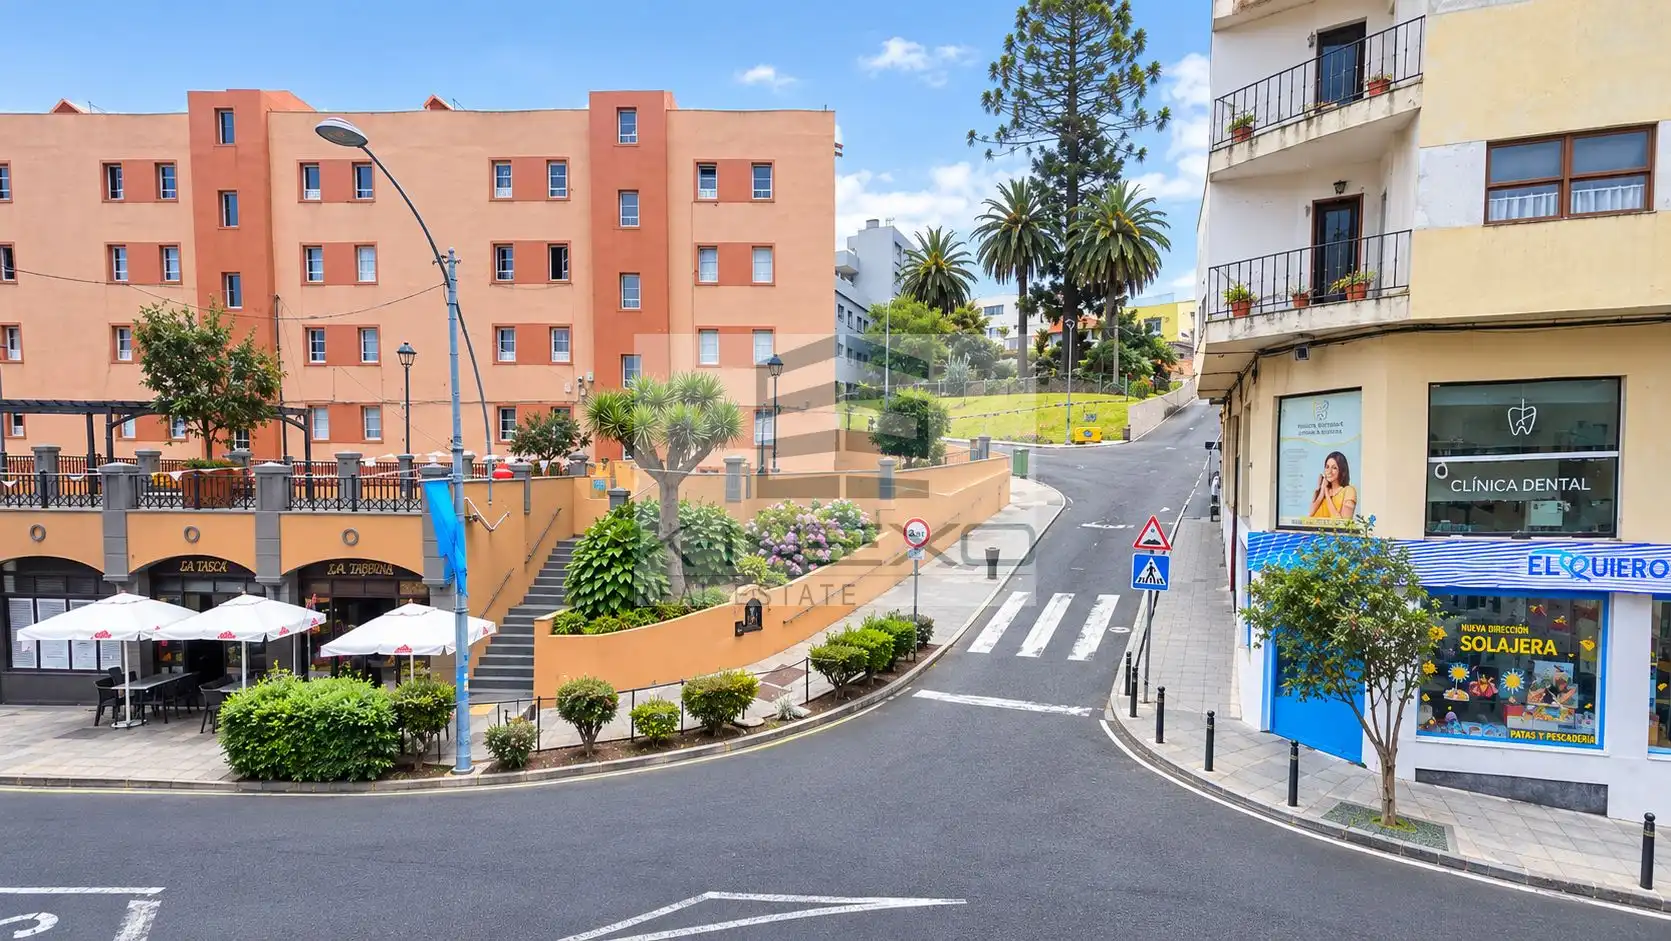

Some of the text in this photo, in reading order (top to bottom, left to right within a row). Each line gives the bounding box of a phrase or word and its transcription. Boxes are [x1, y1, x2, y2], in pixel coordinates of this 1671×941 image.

[1450, 476, 1591, 492] CLÍNICA DENTAL
[179, 560, 228, 572] LA TASCA
[1461, 623, 1487, 633] NUEVA
[1460, 635, 1558, 656] SOLAJERA
[1510, 730, 1537, 740] PATAS
[1538, 731, 1546, 741] Y
